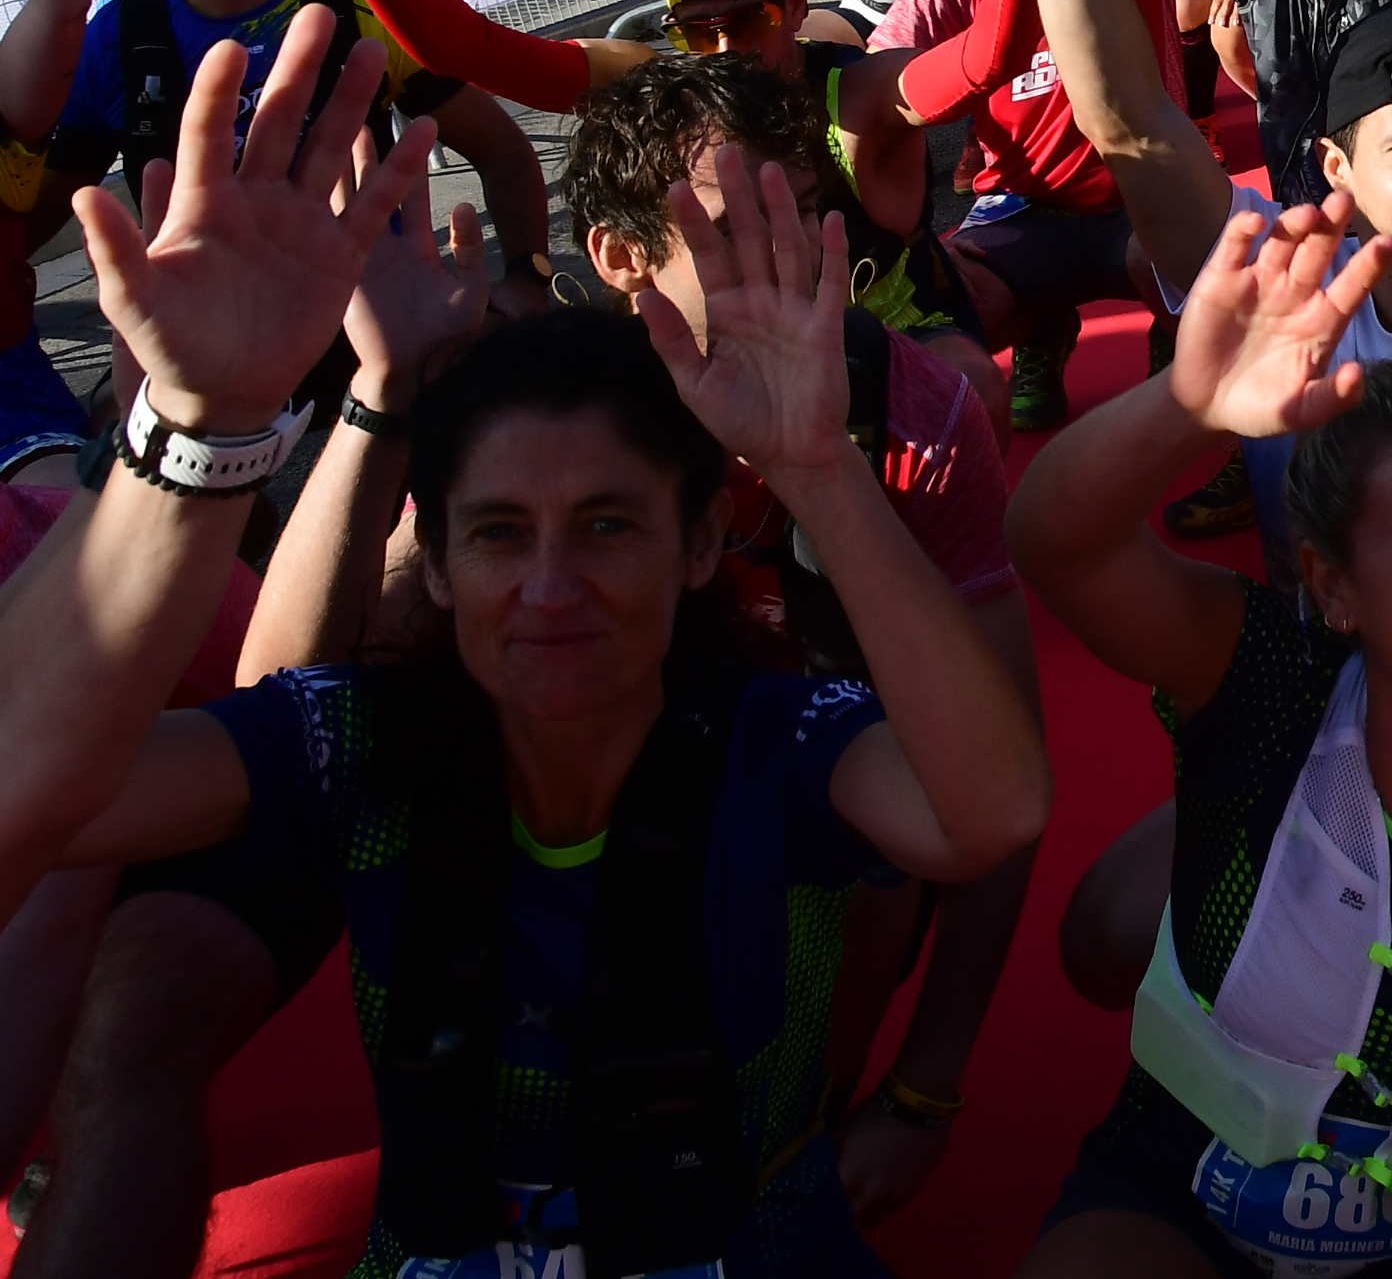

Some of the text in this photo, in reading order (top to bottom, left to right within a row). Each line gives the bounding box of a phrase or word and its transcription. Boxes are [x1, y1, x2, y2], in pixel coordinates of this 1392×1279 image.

[1343, 887, 1362, 904] 250
[1267, 1230, 1316, 1252] MARIA
[1319, 1238, 1385, 1253] MOLINER
